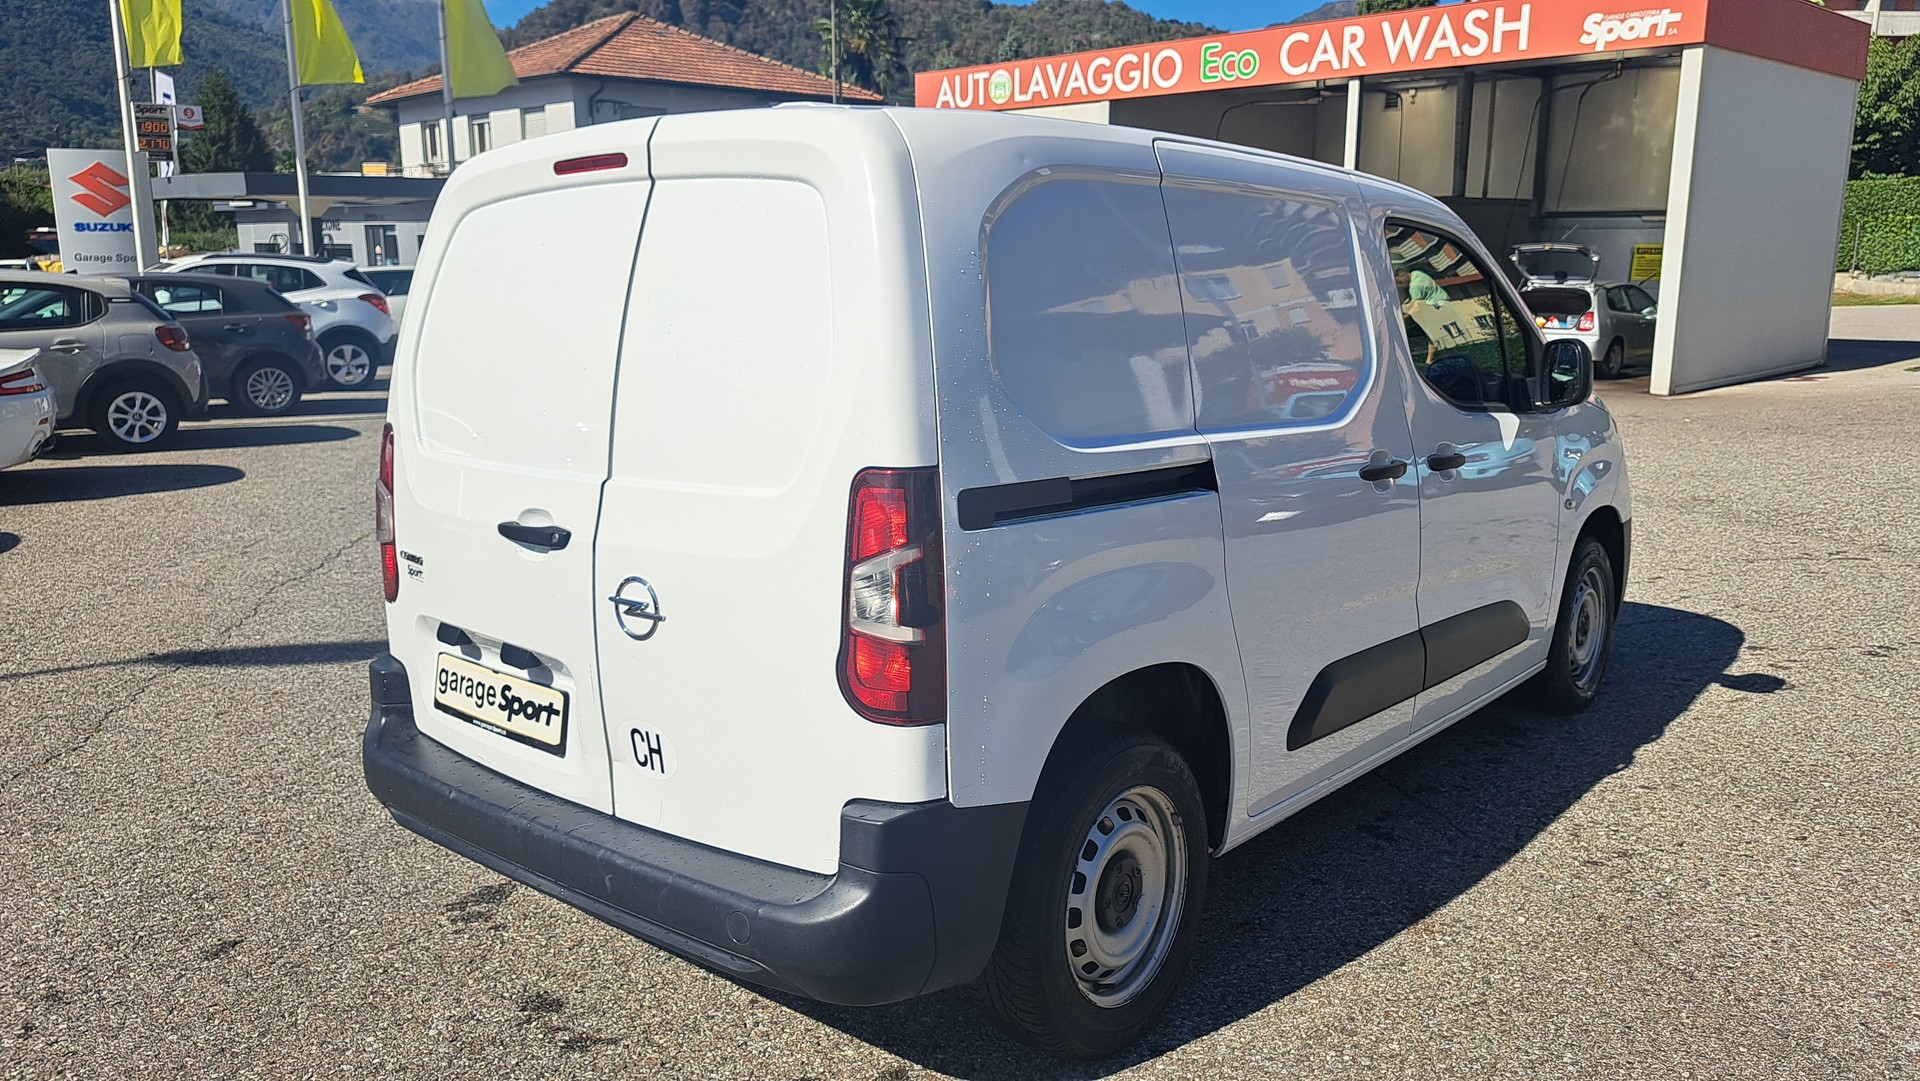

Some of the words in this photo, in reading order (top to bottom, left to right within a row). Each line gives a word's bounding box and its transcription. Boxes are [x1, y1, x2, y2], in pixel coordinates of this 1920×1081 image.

[1578, 8, 1682, 51] Sport
[1667, 27, 1678, 36] SA
[935, 48, 1182, 109] AUTOLAVAGGIO
[1200, 42, 1260, 83] Eco
[1279, 25, 1368, 76] CAR
[1381, 3, 1531, 63] WASH
[135, 104, 167, 116] Sport
[73, 222, 134, 232] SUZUK
[74, 253, 113, 264] Garage
[116, 253, 137, 264] Spo
[408, 564, 424, 579] Sport
[438, 668, 497, 709] garage
[498, 684, 561, 727] Sport
[630, 728, 665, 775] CH
